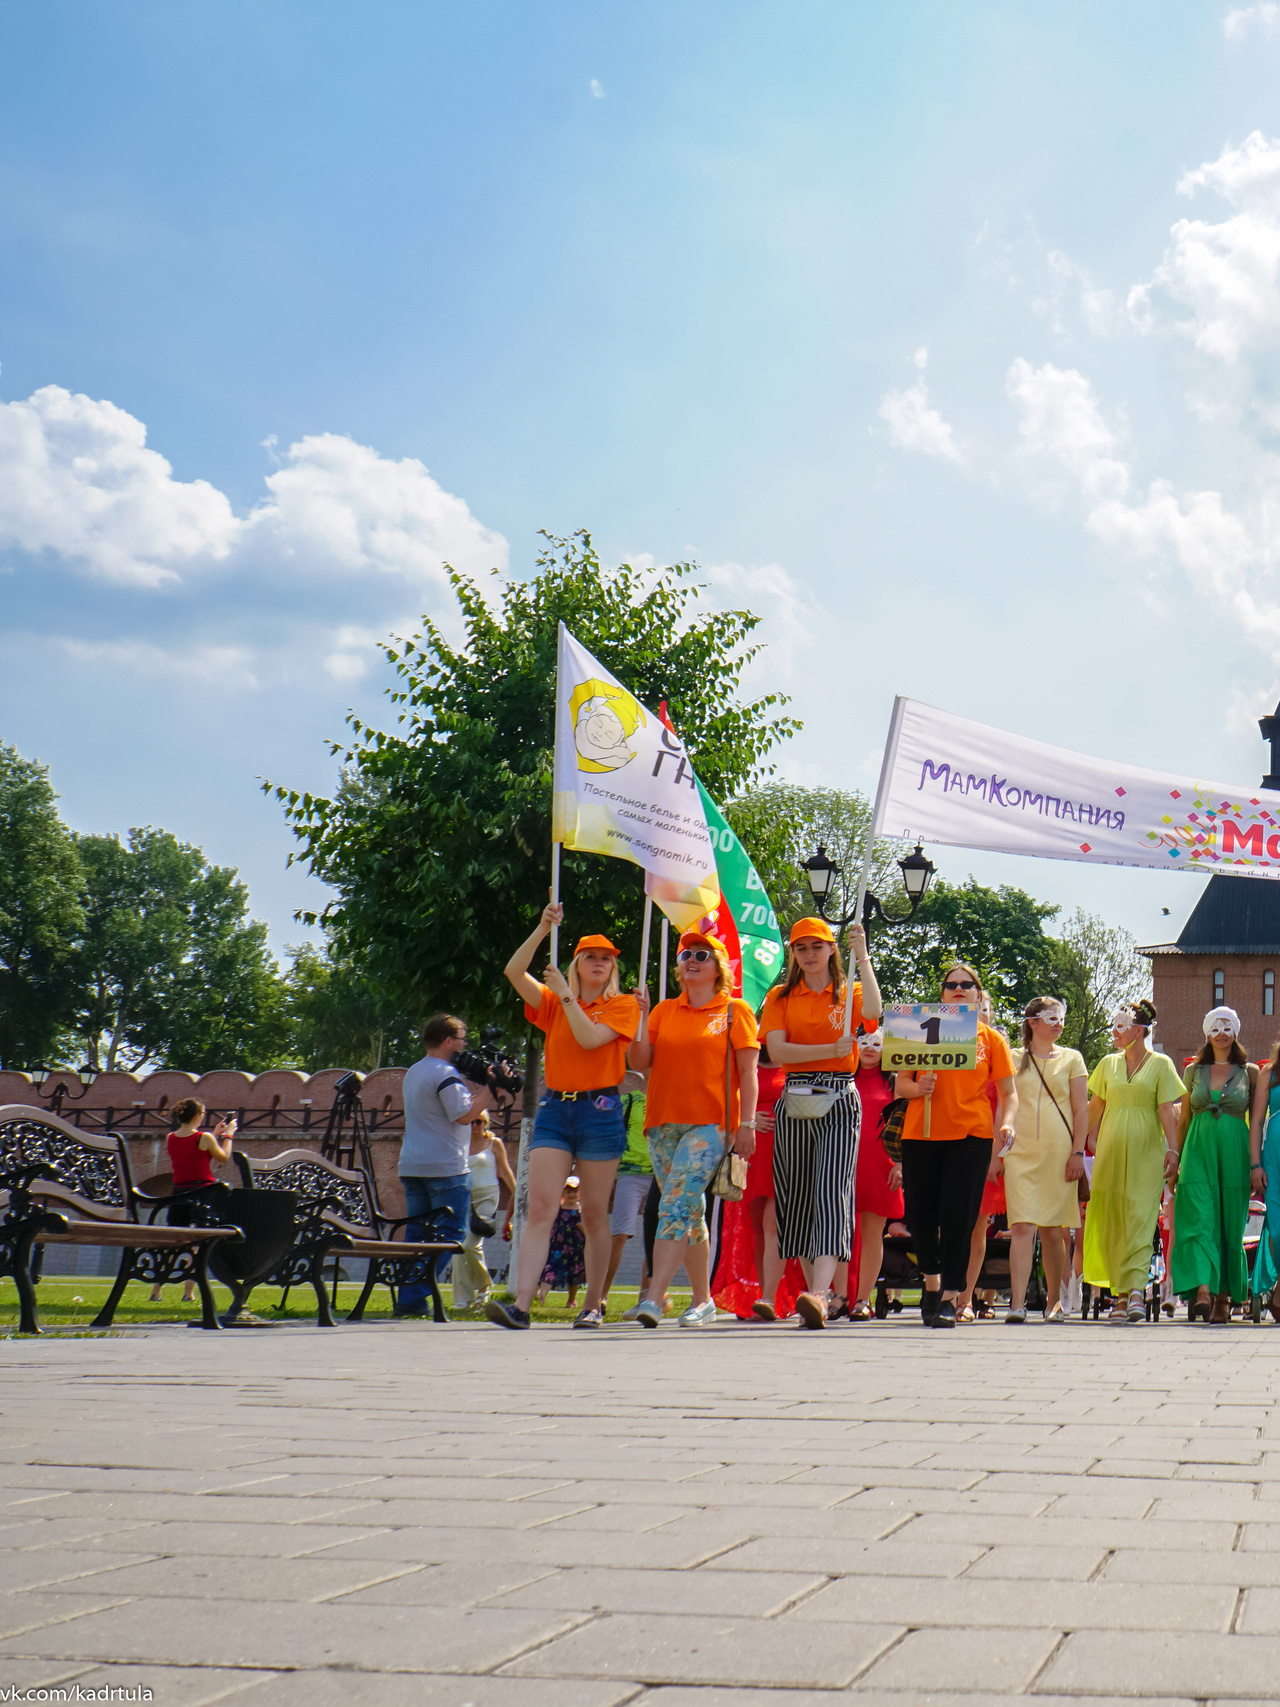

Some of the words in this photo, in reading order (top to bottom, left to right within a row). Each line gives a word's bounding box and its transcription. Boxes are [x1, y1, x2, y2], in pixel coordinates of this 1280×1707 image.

[583, 782, 648, 811] Постельное
[650, 804, 681, 822] белье
[683, 816, 691, 825] и
[617, 808, 652, 825] самых
[606, 828, 709, 870] www.songnomik.ru
[920, 1017, 941, 1045] 1
[891, 1053, 968, 1068] сектор
